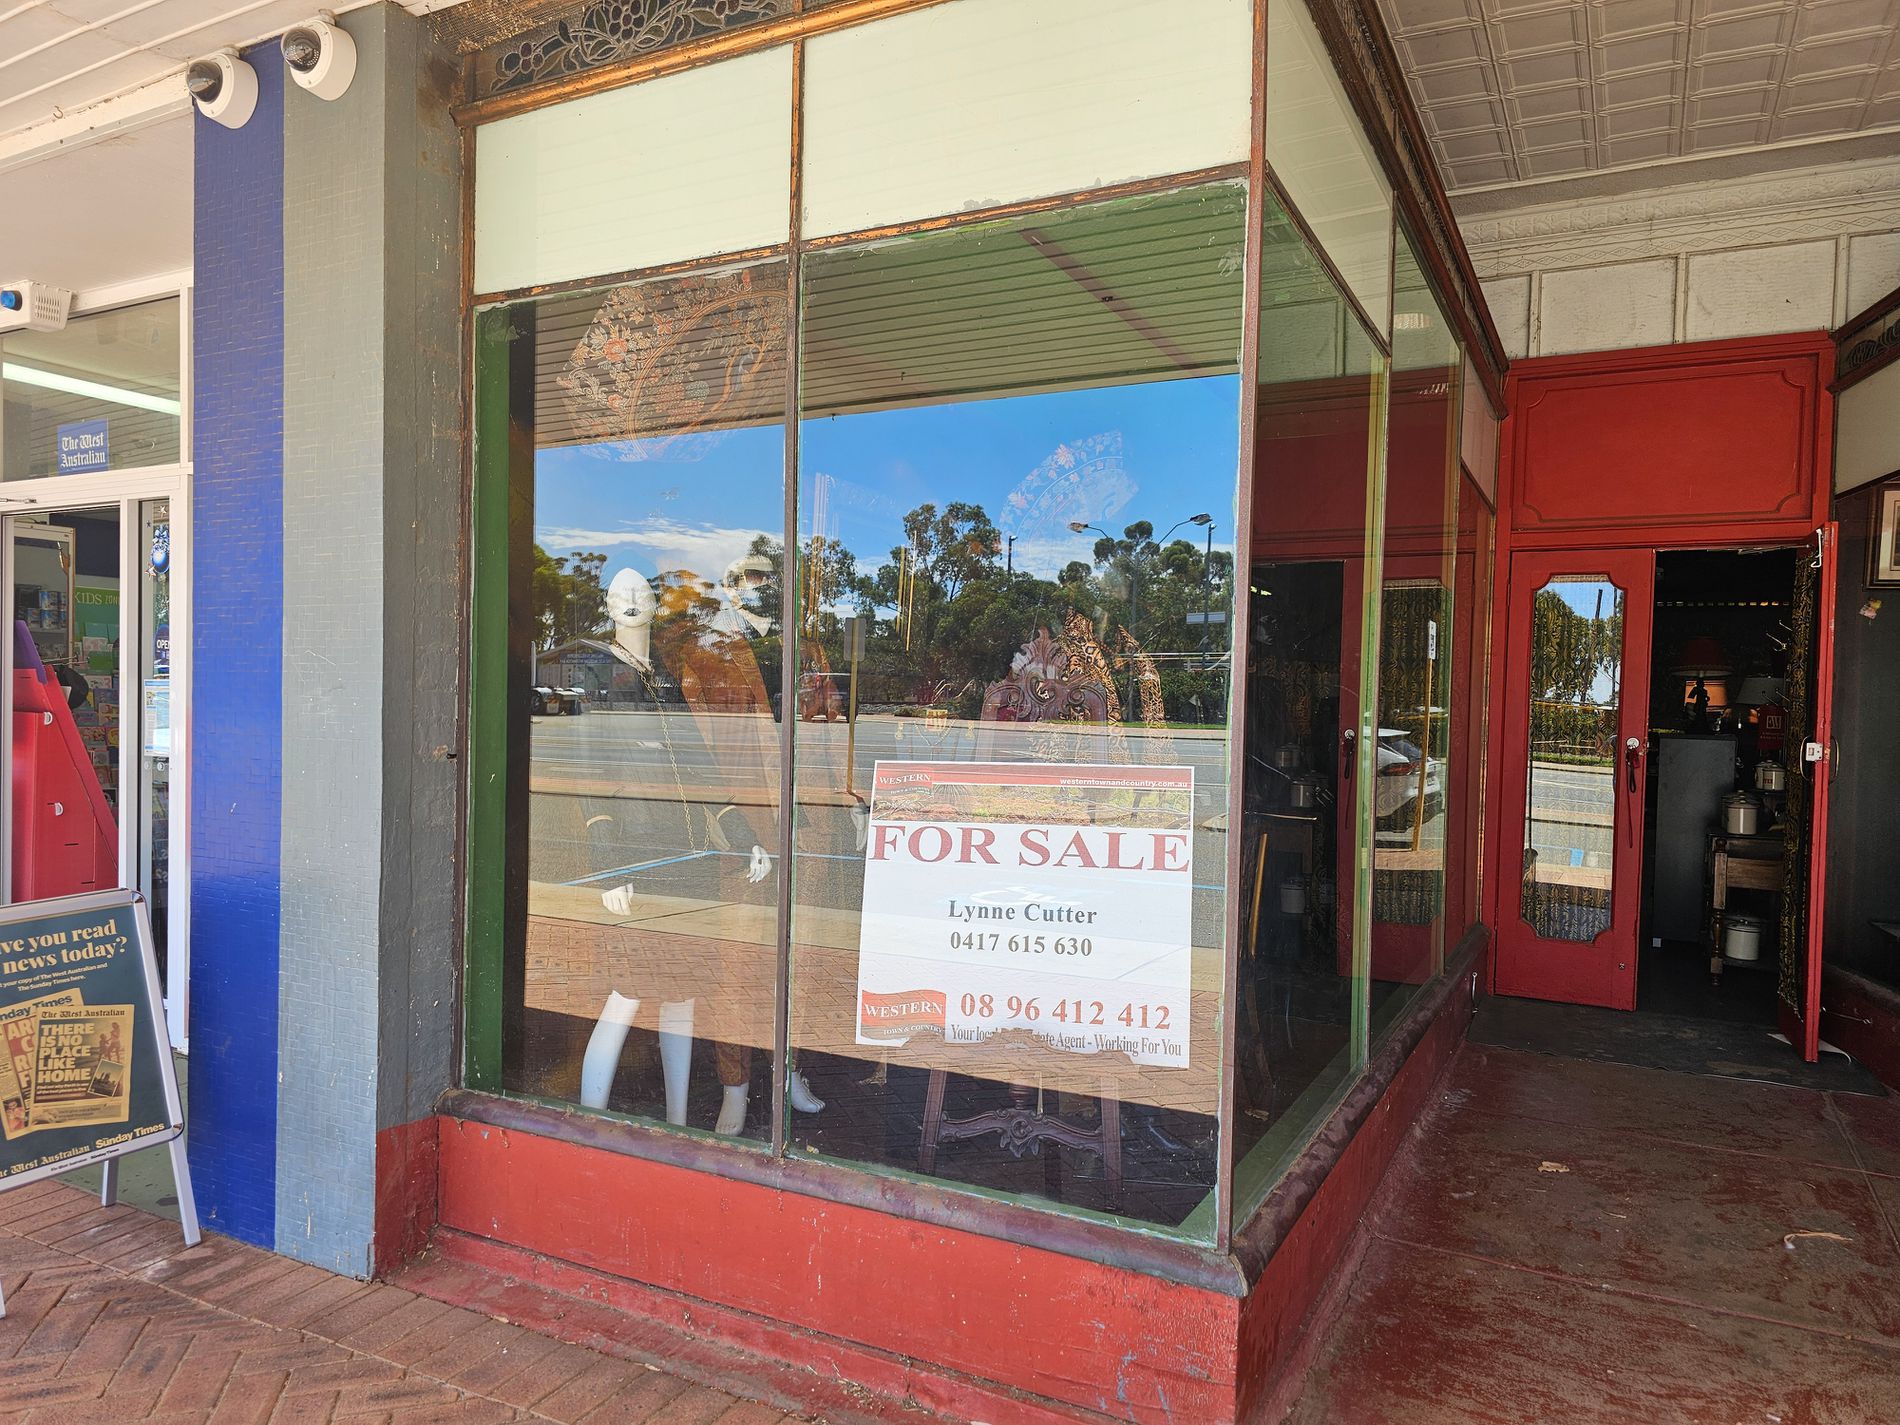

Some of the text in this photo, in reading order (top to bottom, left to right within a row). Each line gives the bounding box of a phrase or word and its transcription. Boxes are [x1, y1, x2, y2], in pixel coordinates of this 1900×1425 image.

[62, 432, 104, 451] The West
[60, 450, 106, 468] Australian
[75, 592, 103, 605] KIDS
[156, 639, 169, 650] OPE
[879, 773, 931, 785] WESTERN
[1060, 778, 1188, 788] westerntownandcountry.com.au
[868, 825, 1190, 873] FOR SALE
[947, 900, 1097, 924] Lynne Cutter
[0, 919, 118, 954] ve you read
[950, 931, 1093, 957] 0417 615 630
[3, 936, 128, 975] news today?
[18, 977, 33, 985] copy
[68, 965, 97, 975] Australian
[30, 981, 52, 990] Sunday
[53, 977, 70, 985] Times
[0, 995, 73, 1021] nday Times
[60, 1010, 82, 1018] West
[84, 1009, 125, 1017] Australian
[863, 1001, 944, 1018] WESTERN
[960, 993, 1171, 1030] 08 96 412 412
[7, 1019, 34, 1040] AR
[41, 1022, 95, 1036] THERE
[41, 1034, 82, 1048] IS NO
[951, 1024, 975, 1041] Your
[1056, 1031, 1086, 1050] Agent
[1094, 1034, 1139, 1057] Working
[1141, 1037, 1160, 1055] For
[1161, 1038, 1182, 1057] You
[40, 1045, 92, 1058] PLACE
[39, 1057, 76, 1070] LIKE
[38, 1067, 92, 1083] HOME
[10, 1159, 38, 1174] West
[40, 1145, 90, 1166] Australian
[95, 1132, 133, 1149] Sunday
[133, 1122, 165, 1138] Times
